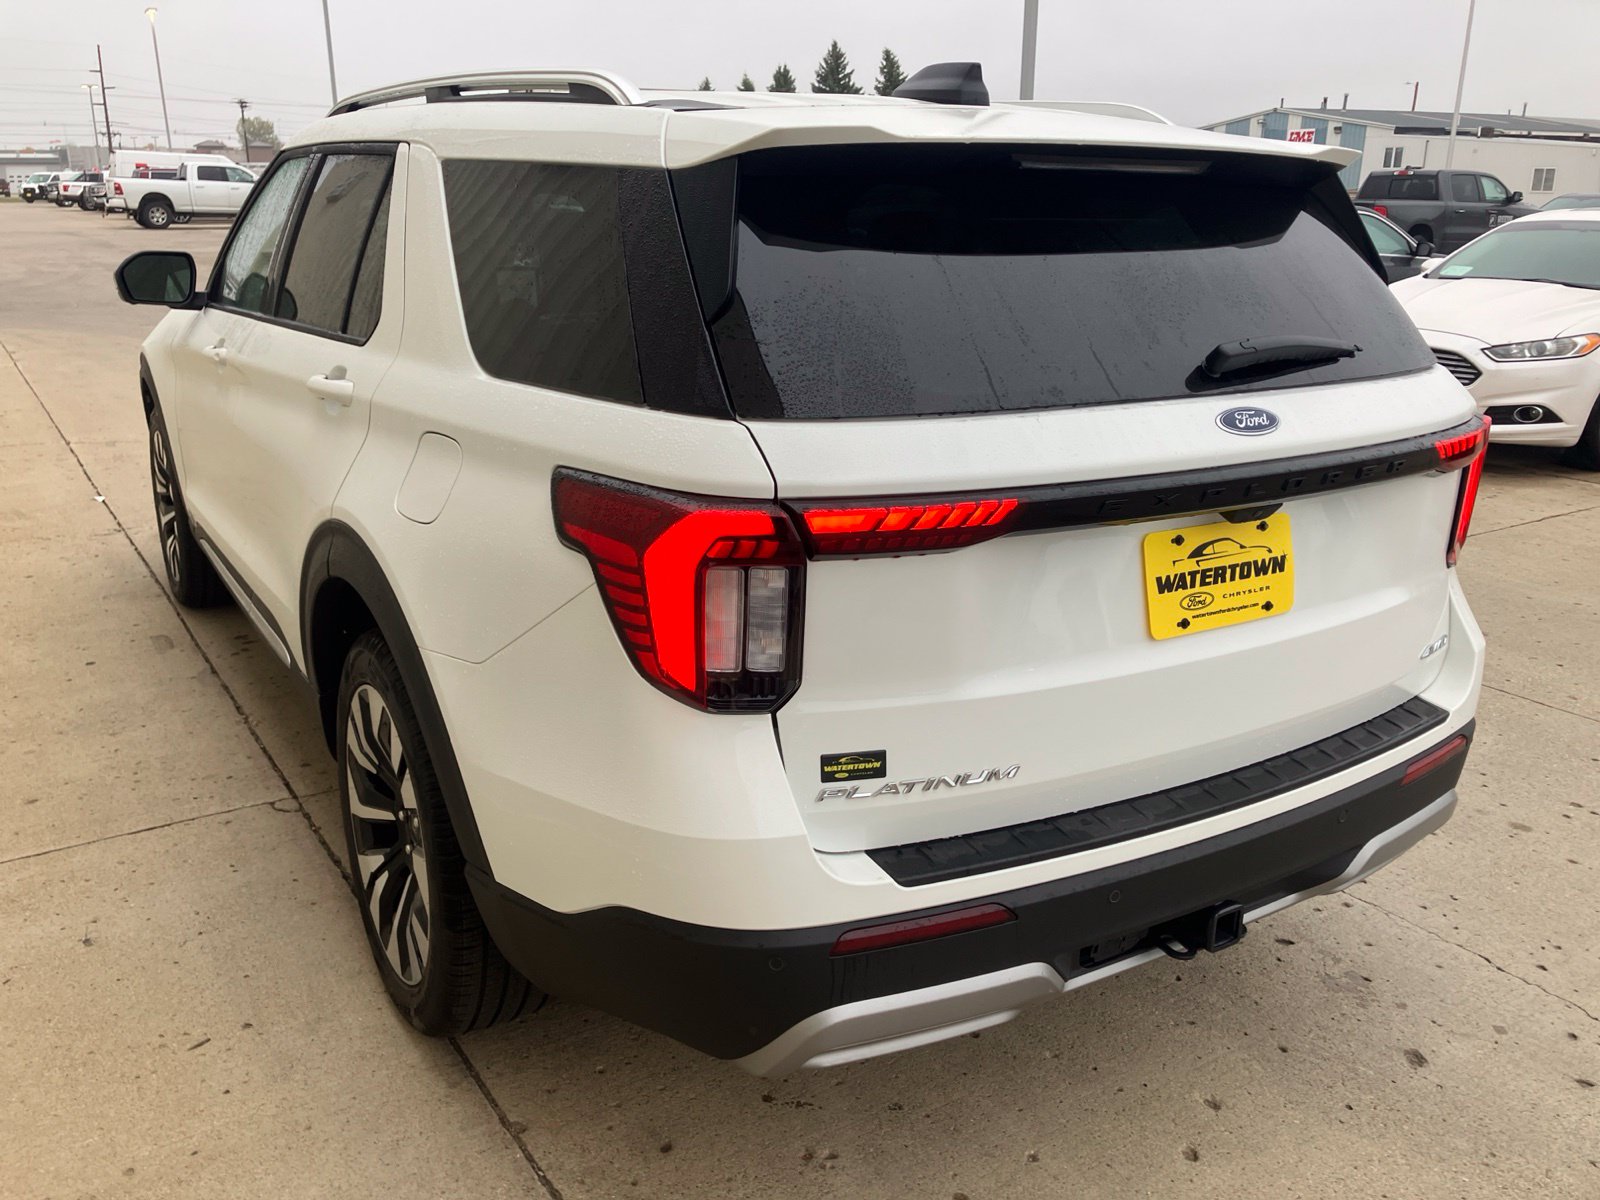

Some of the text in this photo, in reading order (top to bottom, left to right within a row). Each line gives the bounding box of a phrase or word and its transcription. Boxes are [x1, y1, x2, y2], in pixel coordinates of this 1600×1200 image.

[1096, 459, 1407, 514] EXPLORER
[1155, 554, 1287, 595] WATERTOWN
[1222, 585, 1271, 599] CHRYSLER
[815, 764, 1021, 802] PLATINUM
[823, 761, 881, 772] WATERTOWN
